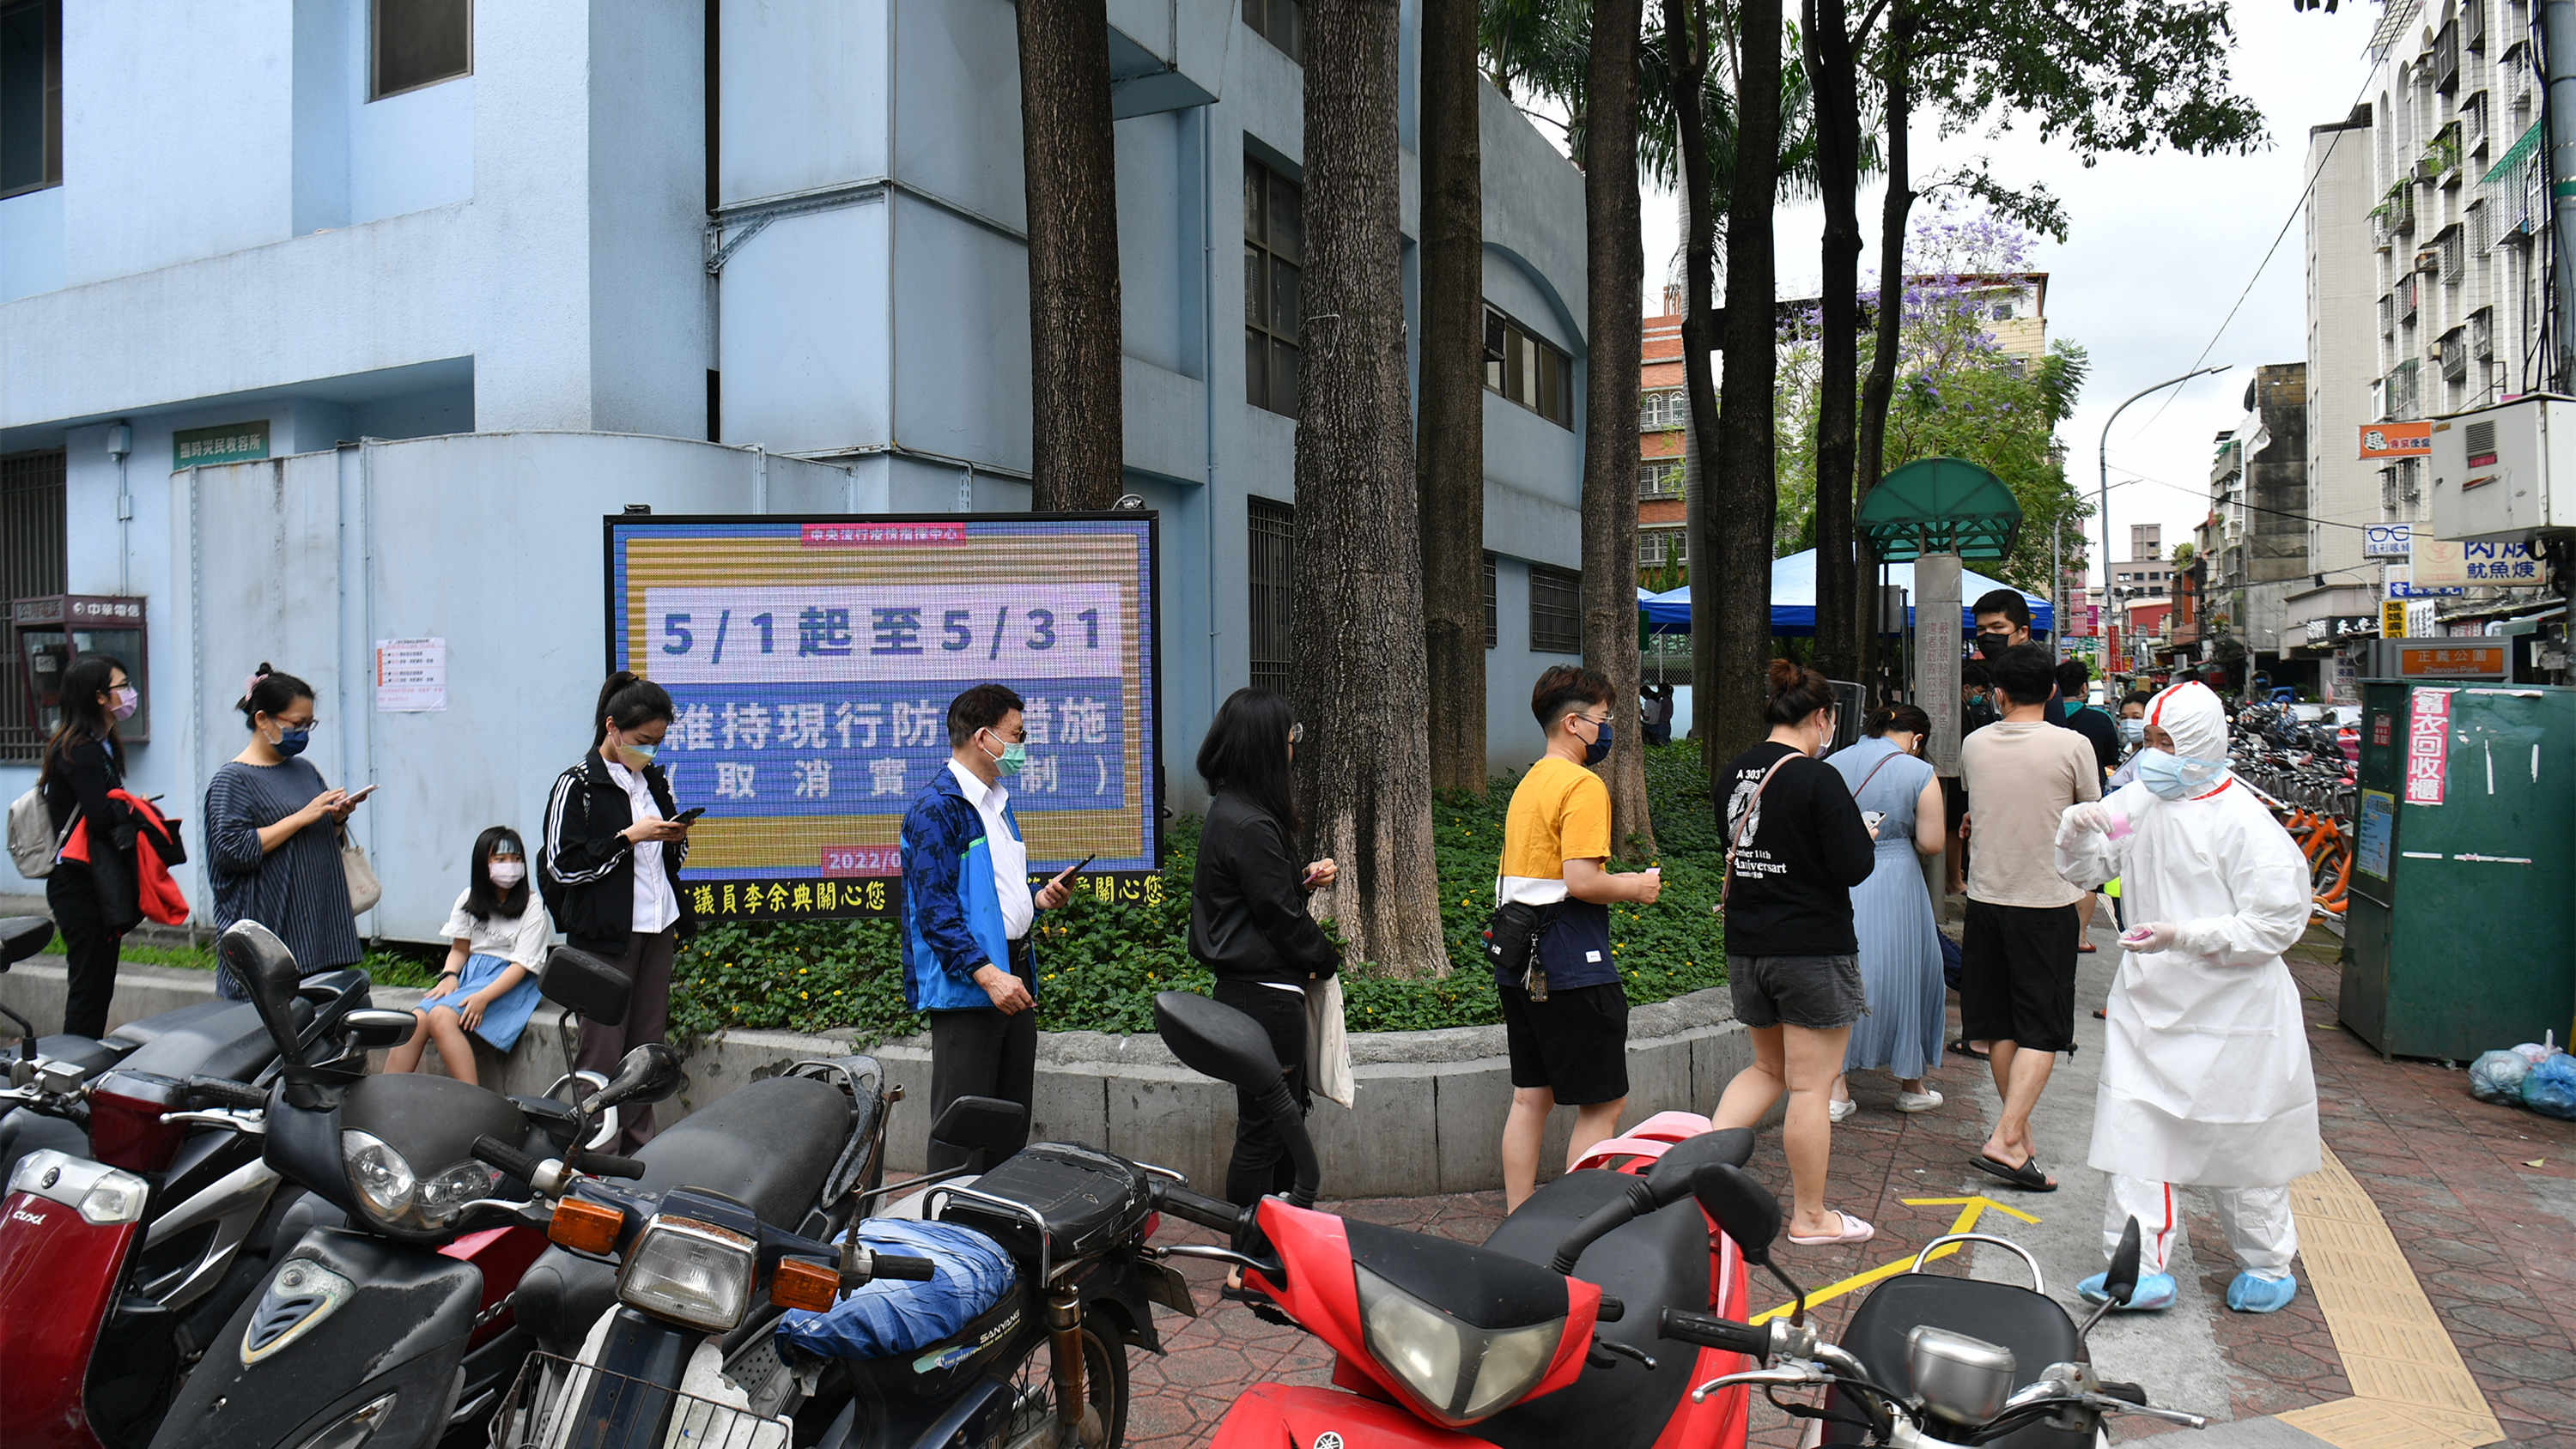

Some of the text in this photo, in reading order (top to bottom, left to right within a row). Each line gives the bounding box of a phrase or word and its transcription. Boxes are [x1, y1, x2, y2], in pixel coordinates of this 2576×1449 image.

[88, 603, 140, 618] 中華電信
[662, 605, 1100, 664] 5/1起至5/31
[2417, 649, 2487, 662] 正義公園
[663, 696, 1107, 751] 維持現行防措施
[2408, 692, 2449, 800] 舊衣回收櫃
[1735, 768, 1744, 779] A
[692, 880, 886, 915] 議員李余典關心您
[979, 1307, 1021, 1344] SANYANG
